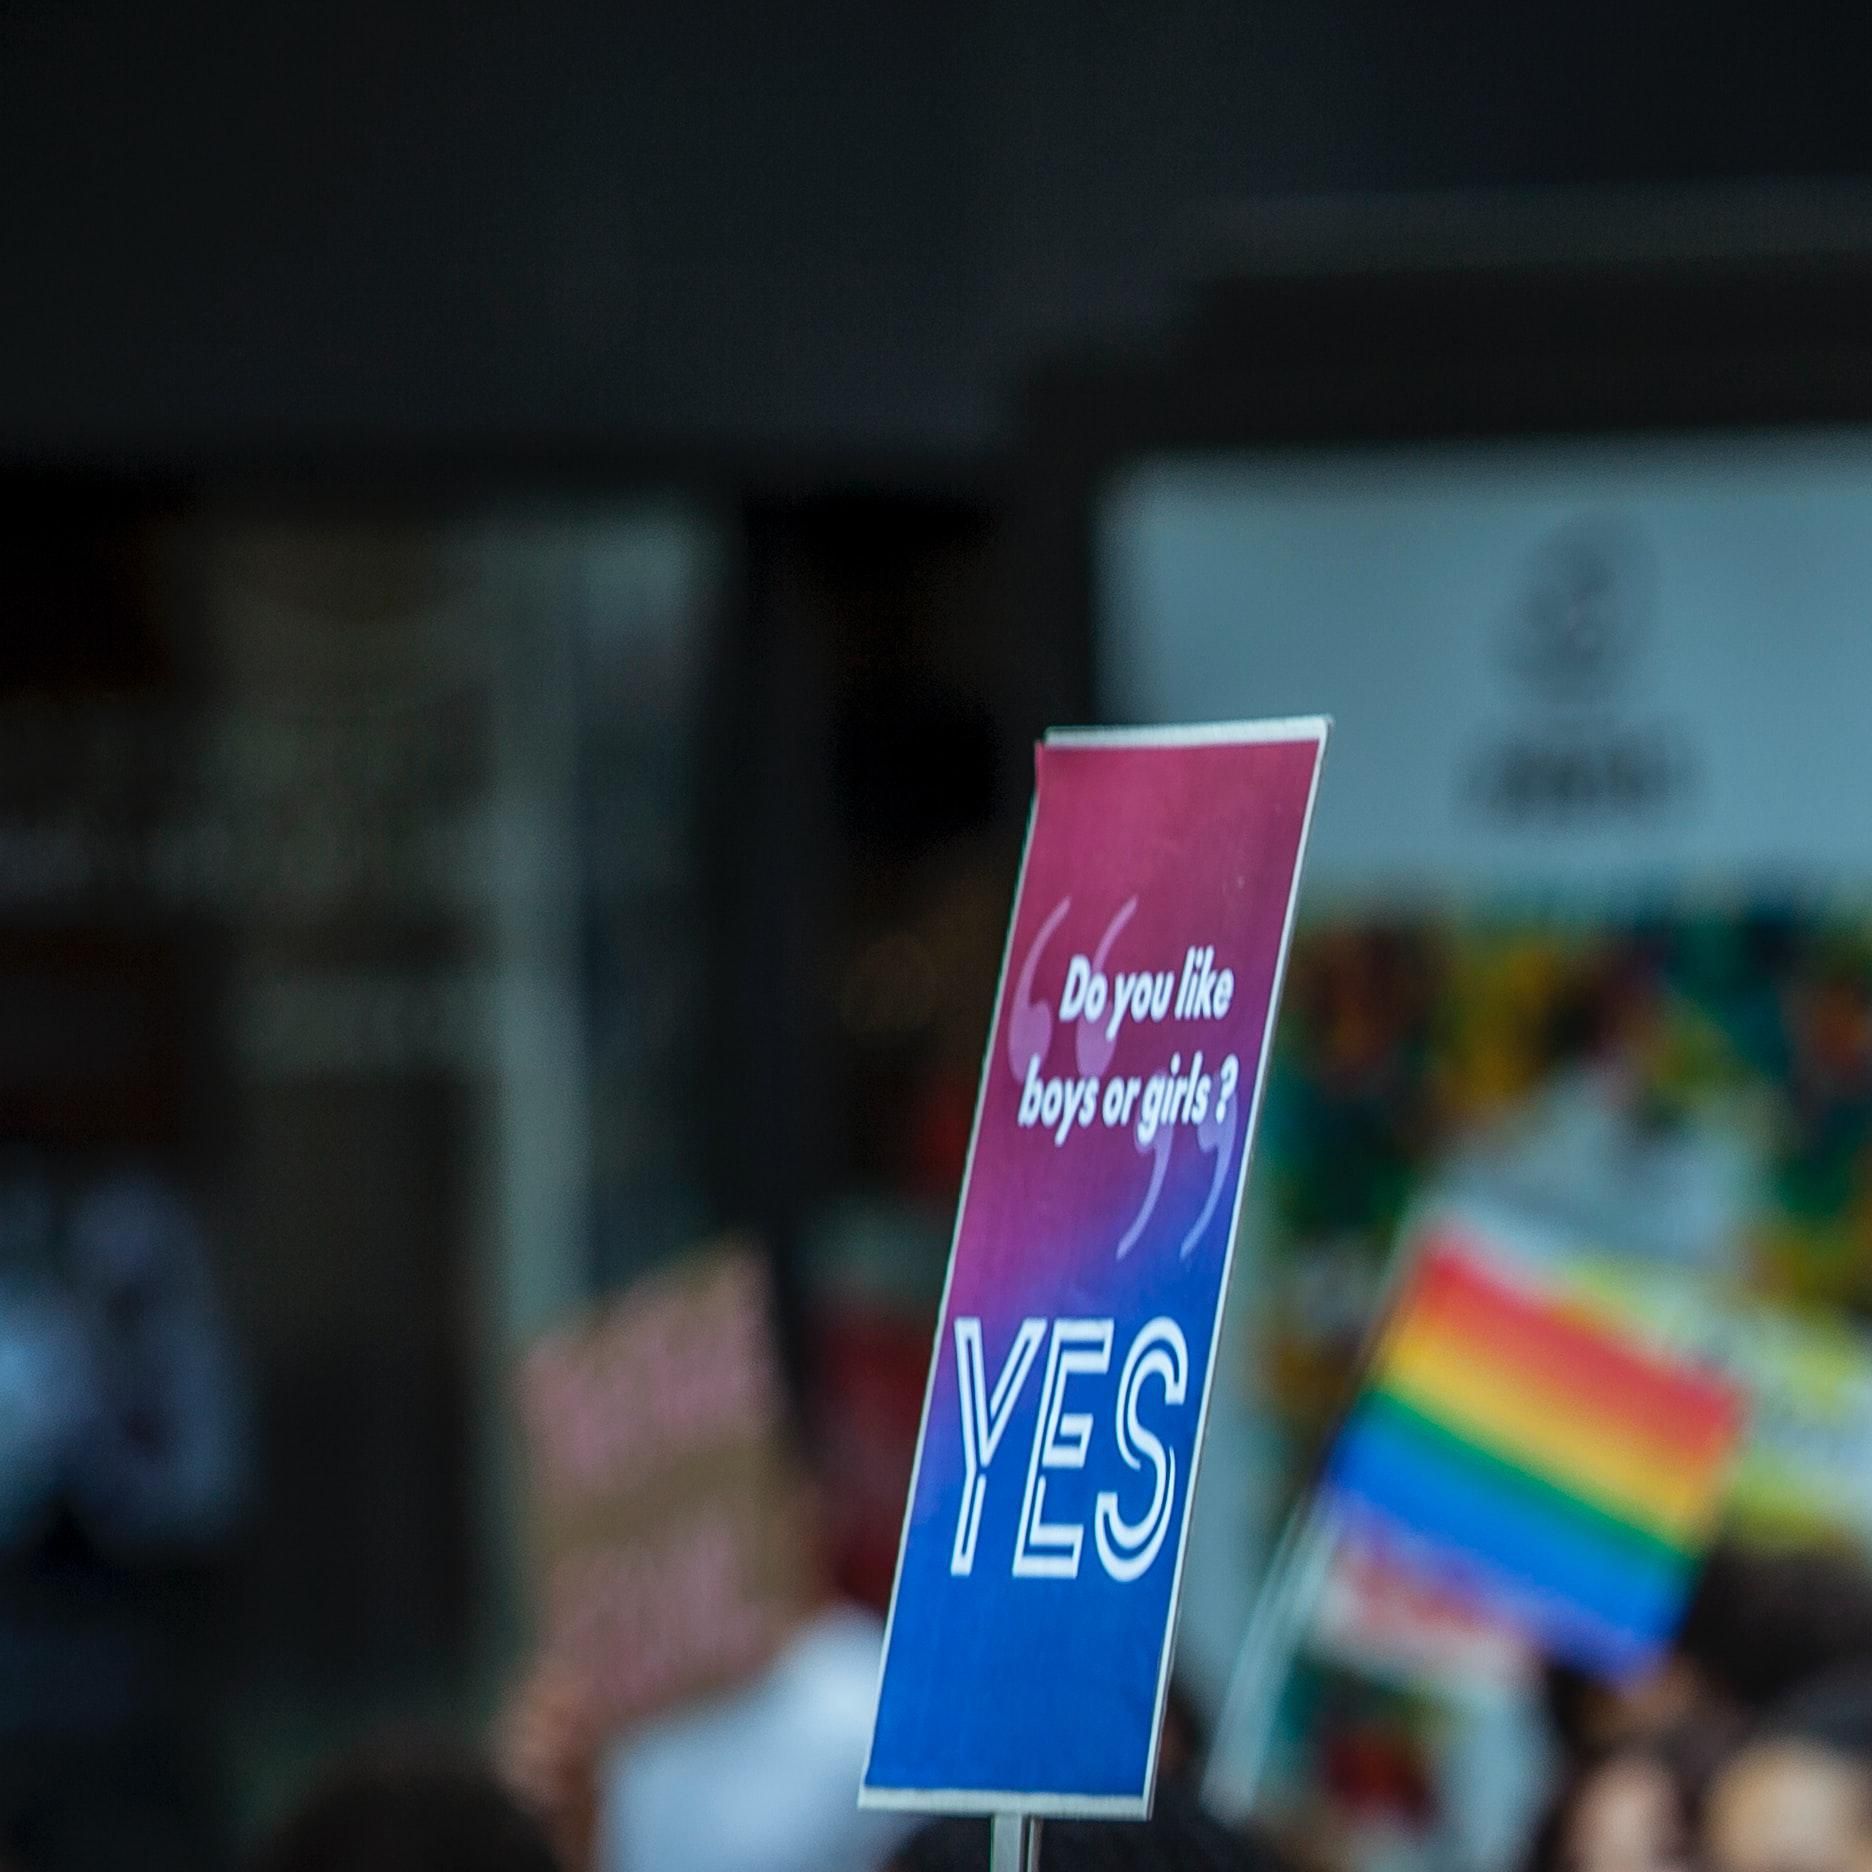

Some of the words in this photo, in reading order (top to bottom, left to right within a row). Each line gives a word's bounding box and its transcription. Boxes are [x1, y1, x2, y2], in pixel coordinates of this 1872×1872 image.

[1059, 954, 1108, 1023] Do
[1106, 971, 1175, 1042] you
[1175, 945, 1235, 1020] like
[1018, 1053, 1099, 1148] boys
[1102, 1076, 1141, 1128] or
[951, 1316, 1188, 1582] YES
